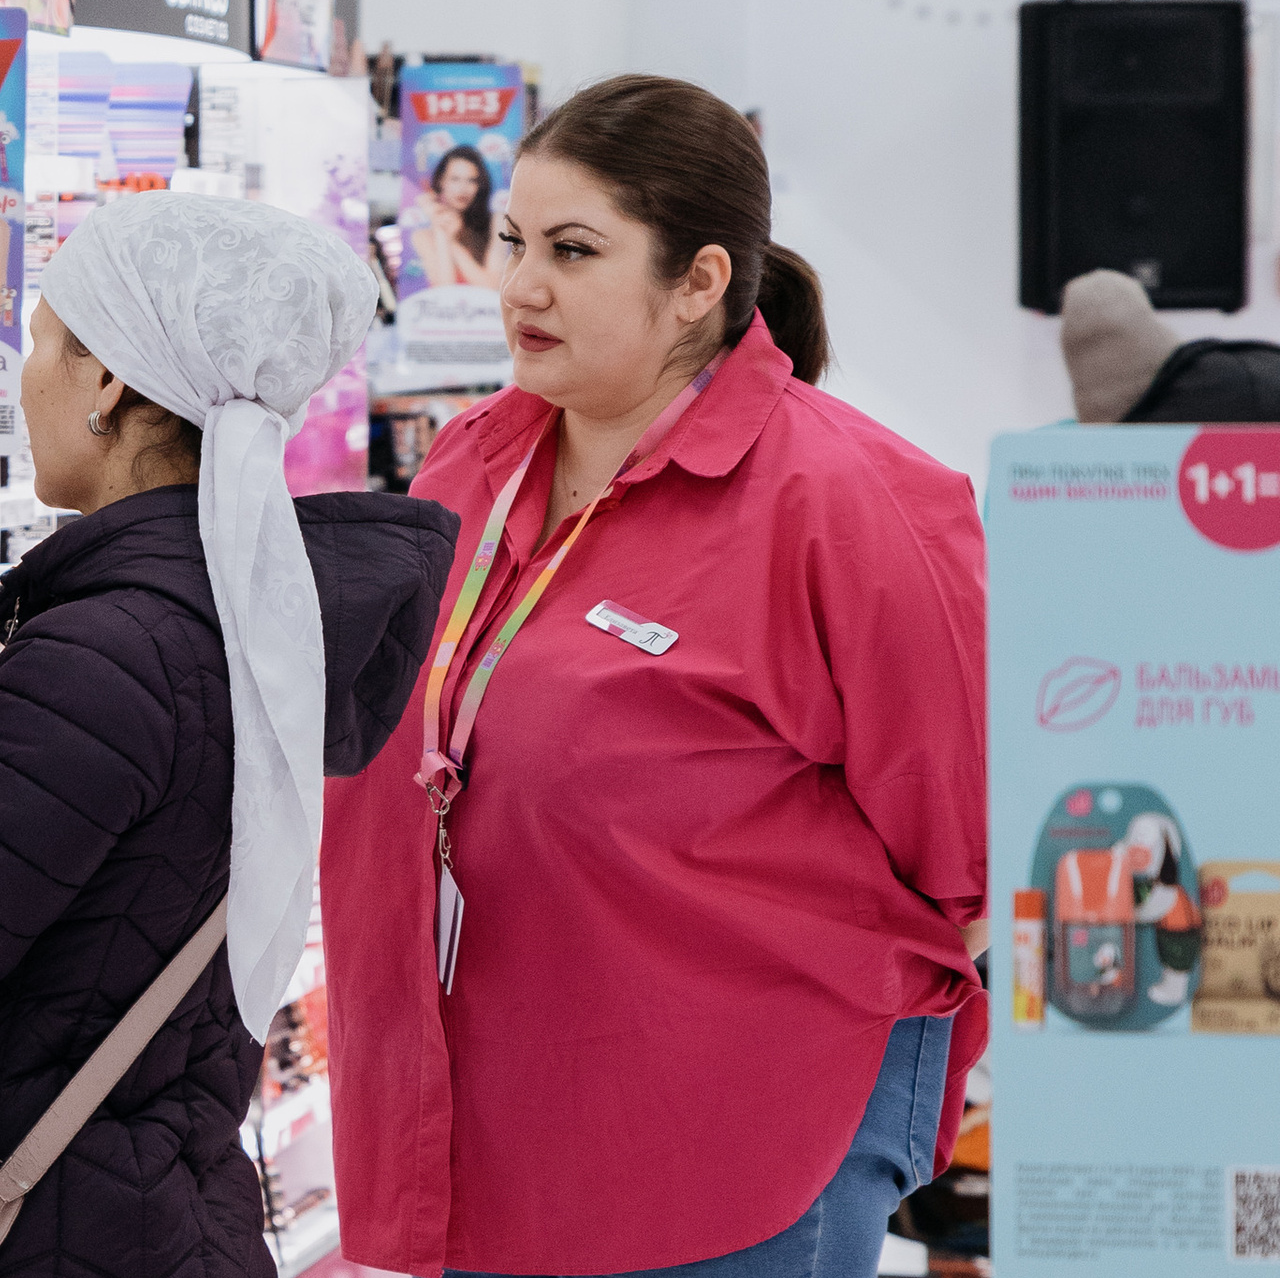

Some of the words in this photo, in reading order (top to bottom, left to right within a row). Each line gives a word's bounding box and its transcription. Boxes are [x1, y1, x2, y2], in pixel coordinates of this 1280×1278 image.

[426, 91, 500, 116] 1+1=3
[1135, 662, 1280, 691] БАЛЬЗАМ
[1133, 696, 1194, 727] ДЛЯ
[1201, 696, 1256, 726] ГУБ
